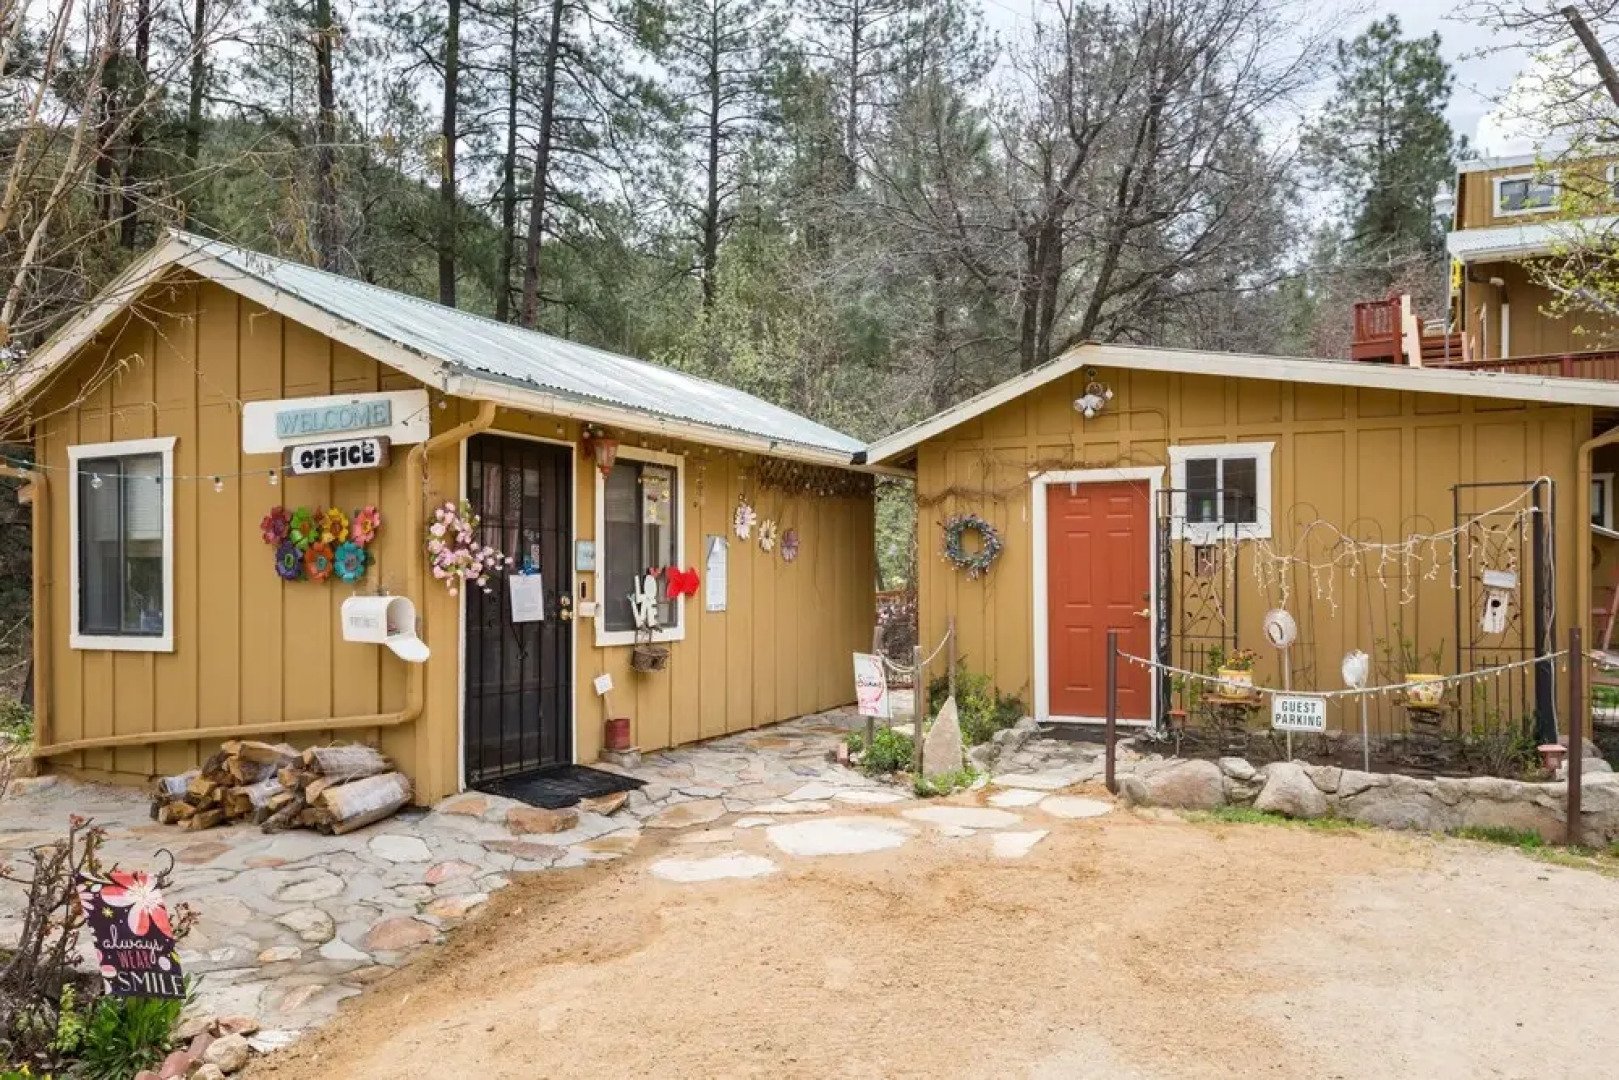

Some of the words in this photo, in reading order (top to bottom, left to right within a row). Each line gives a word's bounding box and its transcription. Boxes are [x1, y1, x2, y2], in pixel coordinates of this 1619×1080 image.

[278, 403, 388, 434] WELCOME
[300, 440, 376, 469] OFFICE
[1281, 700, 1316, 713] GUEST
[1275, 713, 1322, 728] PARKING
[102, 924, 164, 965] always
[117, 950, 152, 969] WEAR
[117, 971, 184, 997] SMILE
